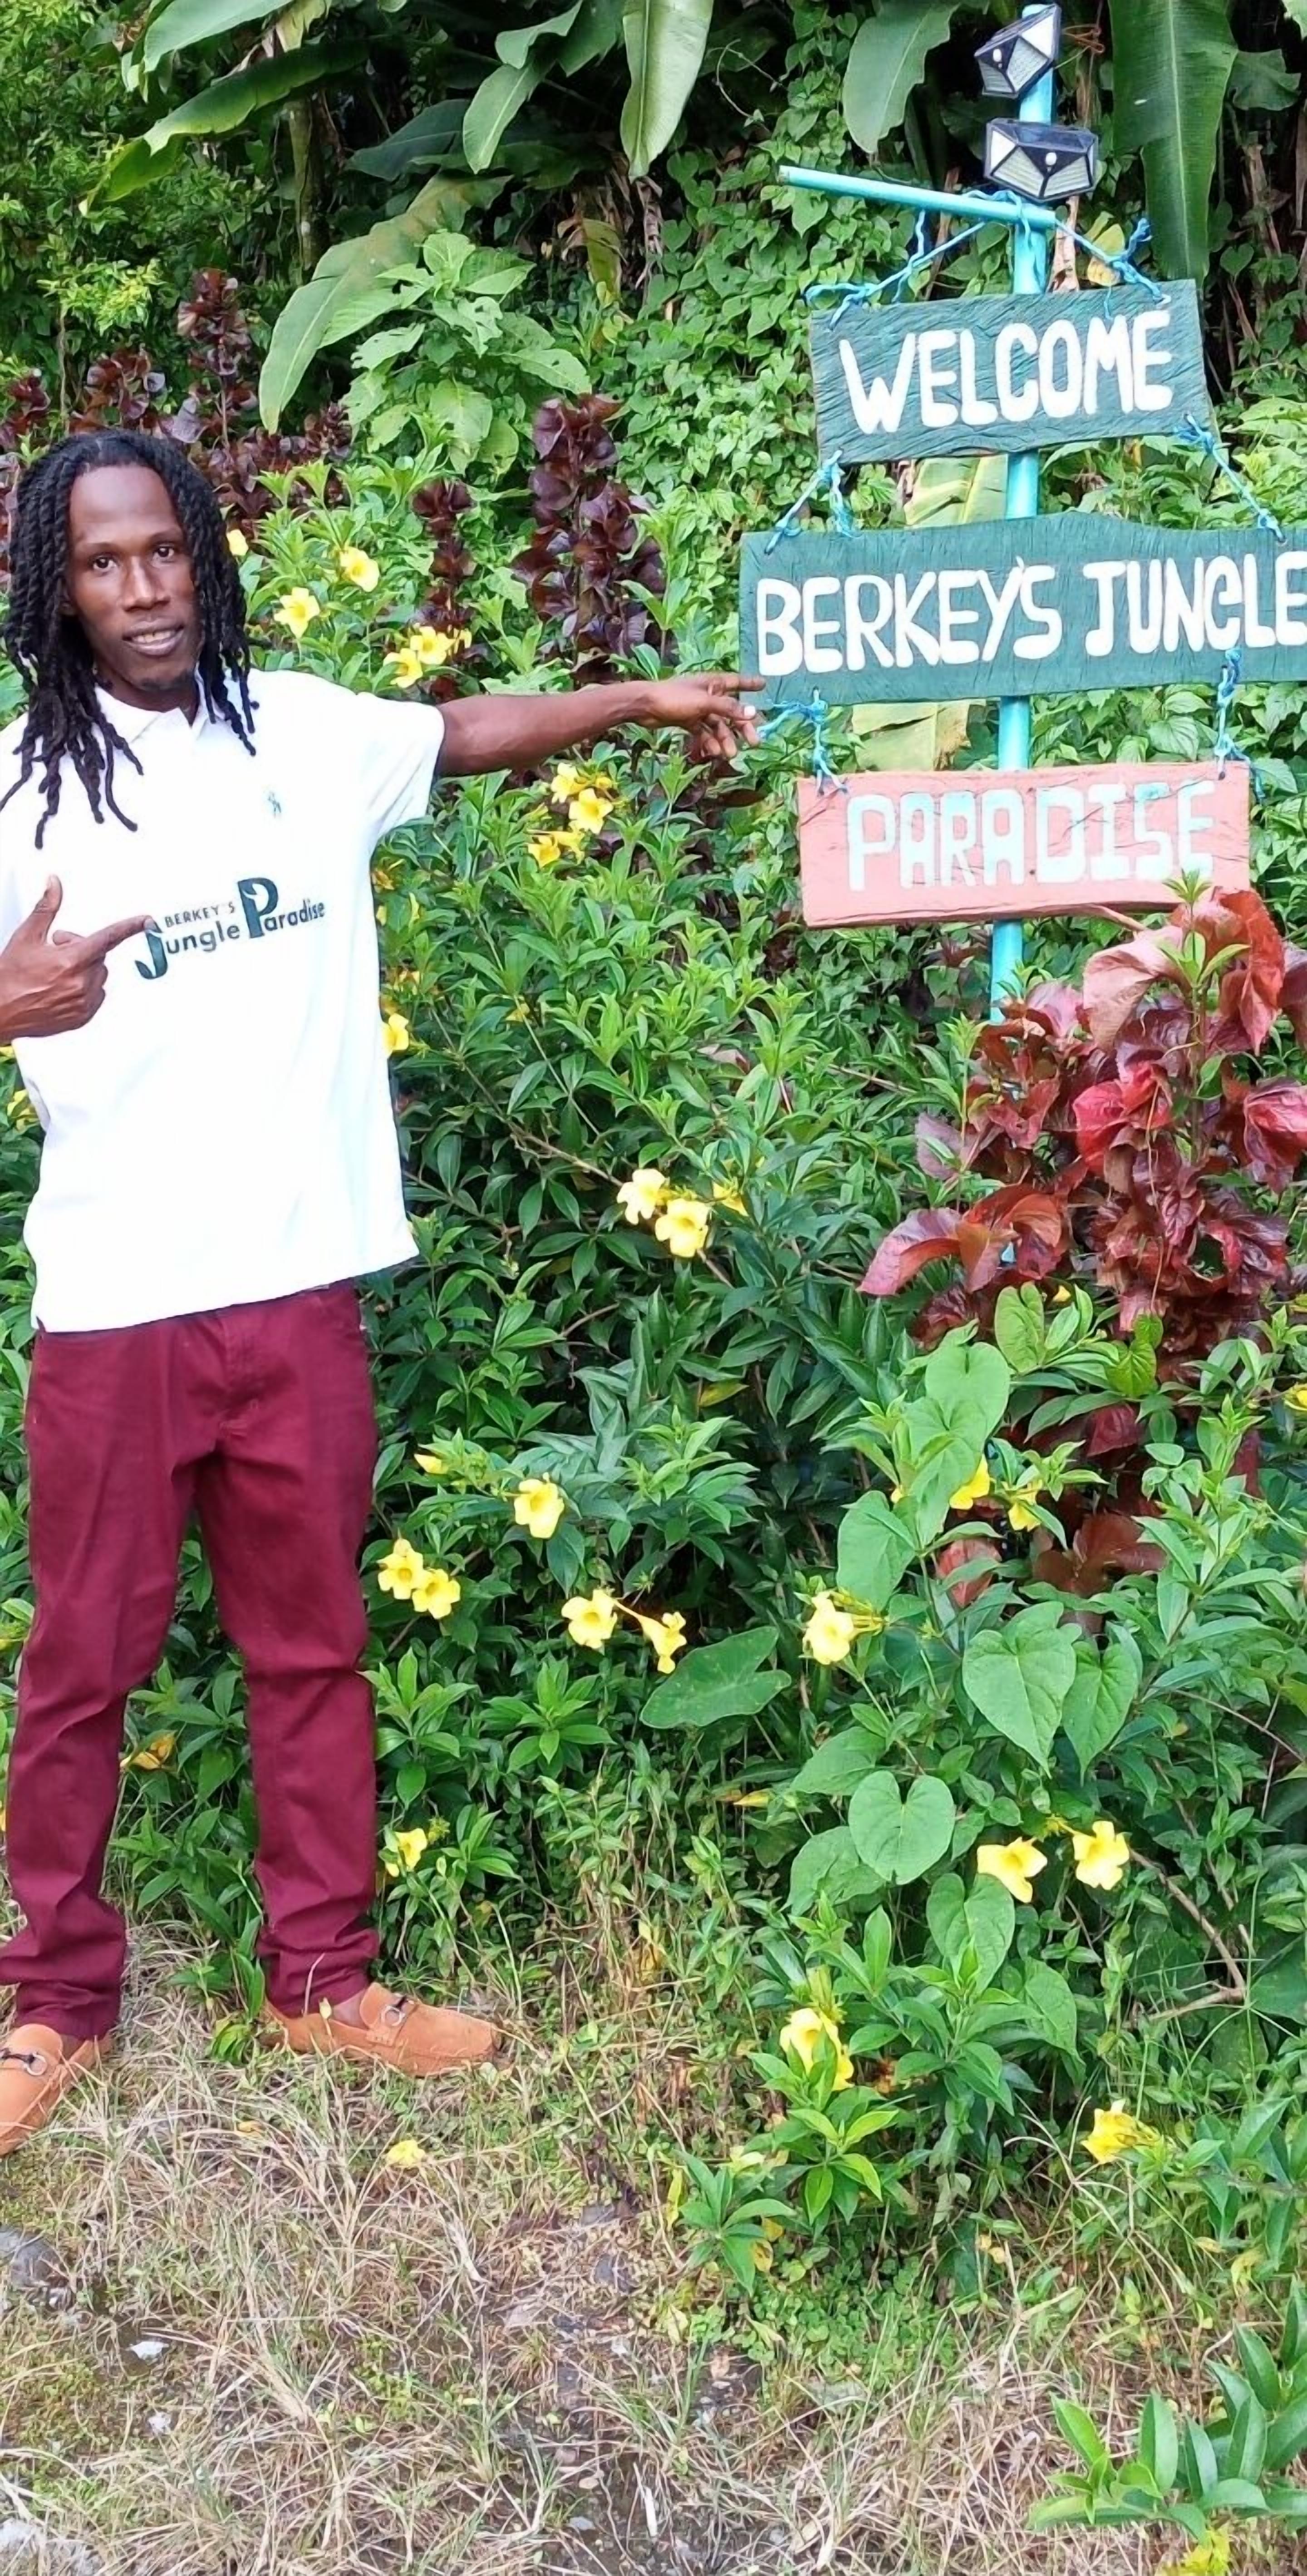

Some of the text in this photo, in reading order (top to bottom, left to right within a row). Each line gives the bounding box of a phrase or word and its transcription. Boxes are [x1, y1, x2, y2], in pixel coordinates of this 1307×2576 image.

[840, 311, 1173, 433] WELCOME
[757, 551, 1307, 676] BERKEY'S JUNGLE
[848, 780, 1215, 890] PARADISE
[135, 878, 325, 979] Jungle Paradise
